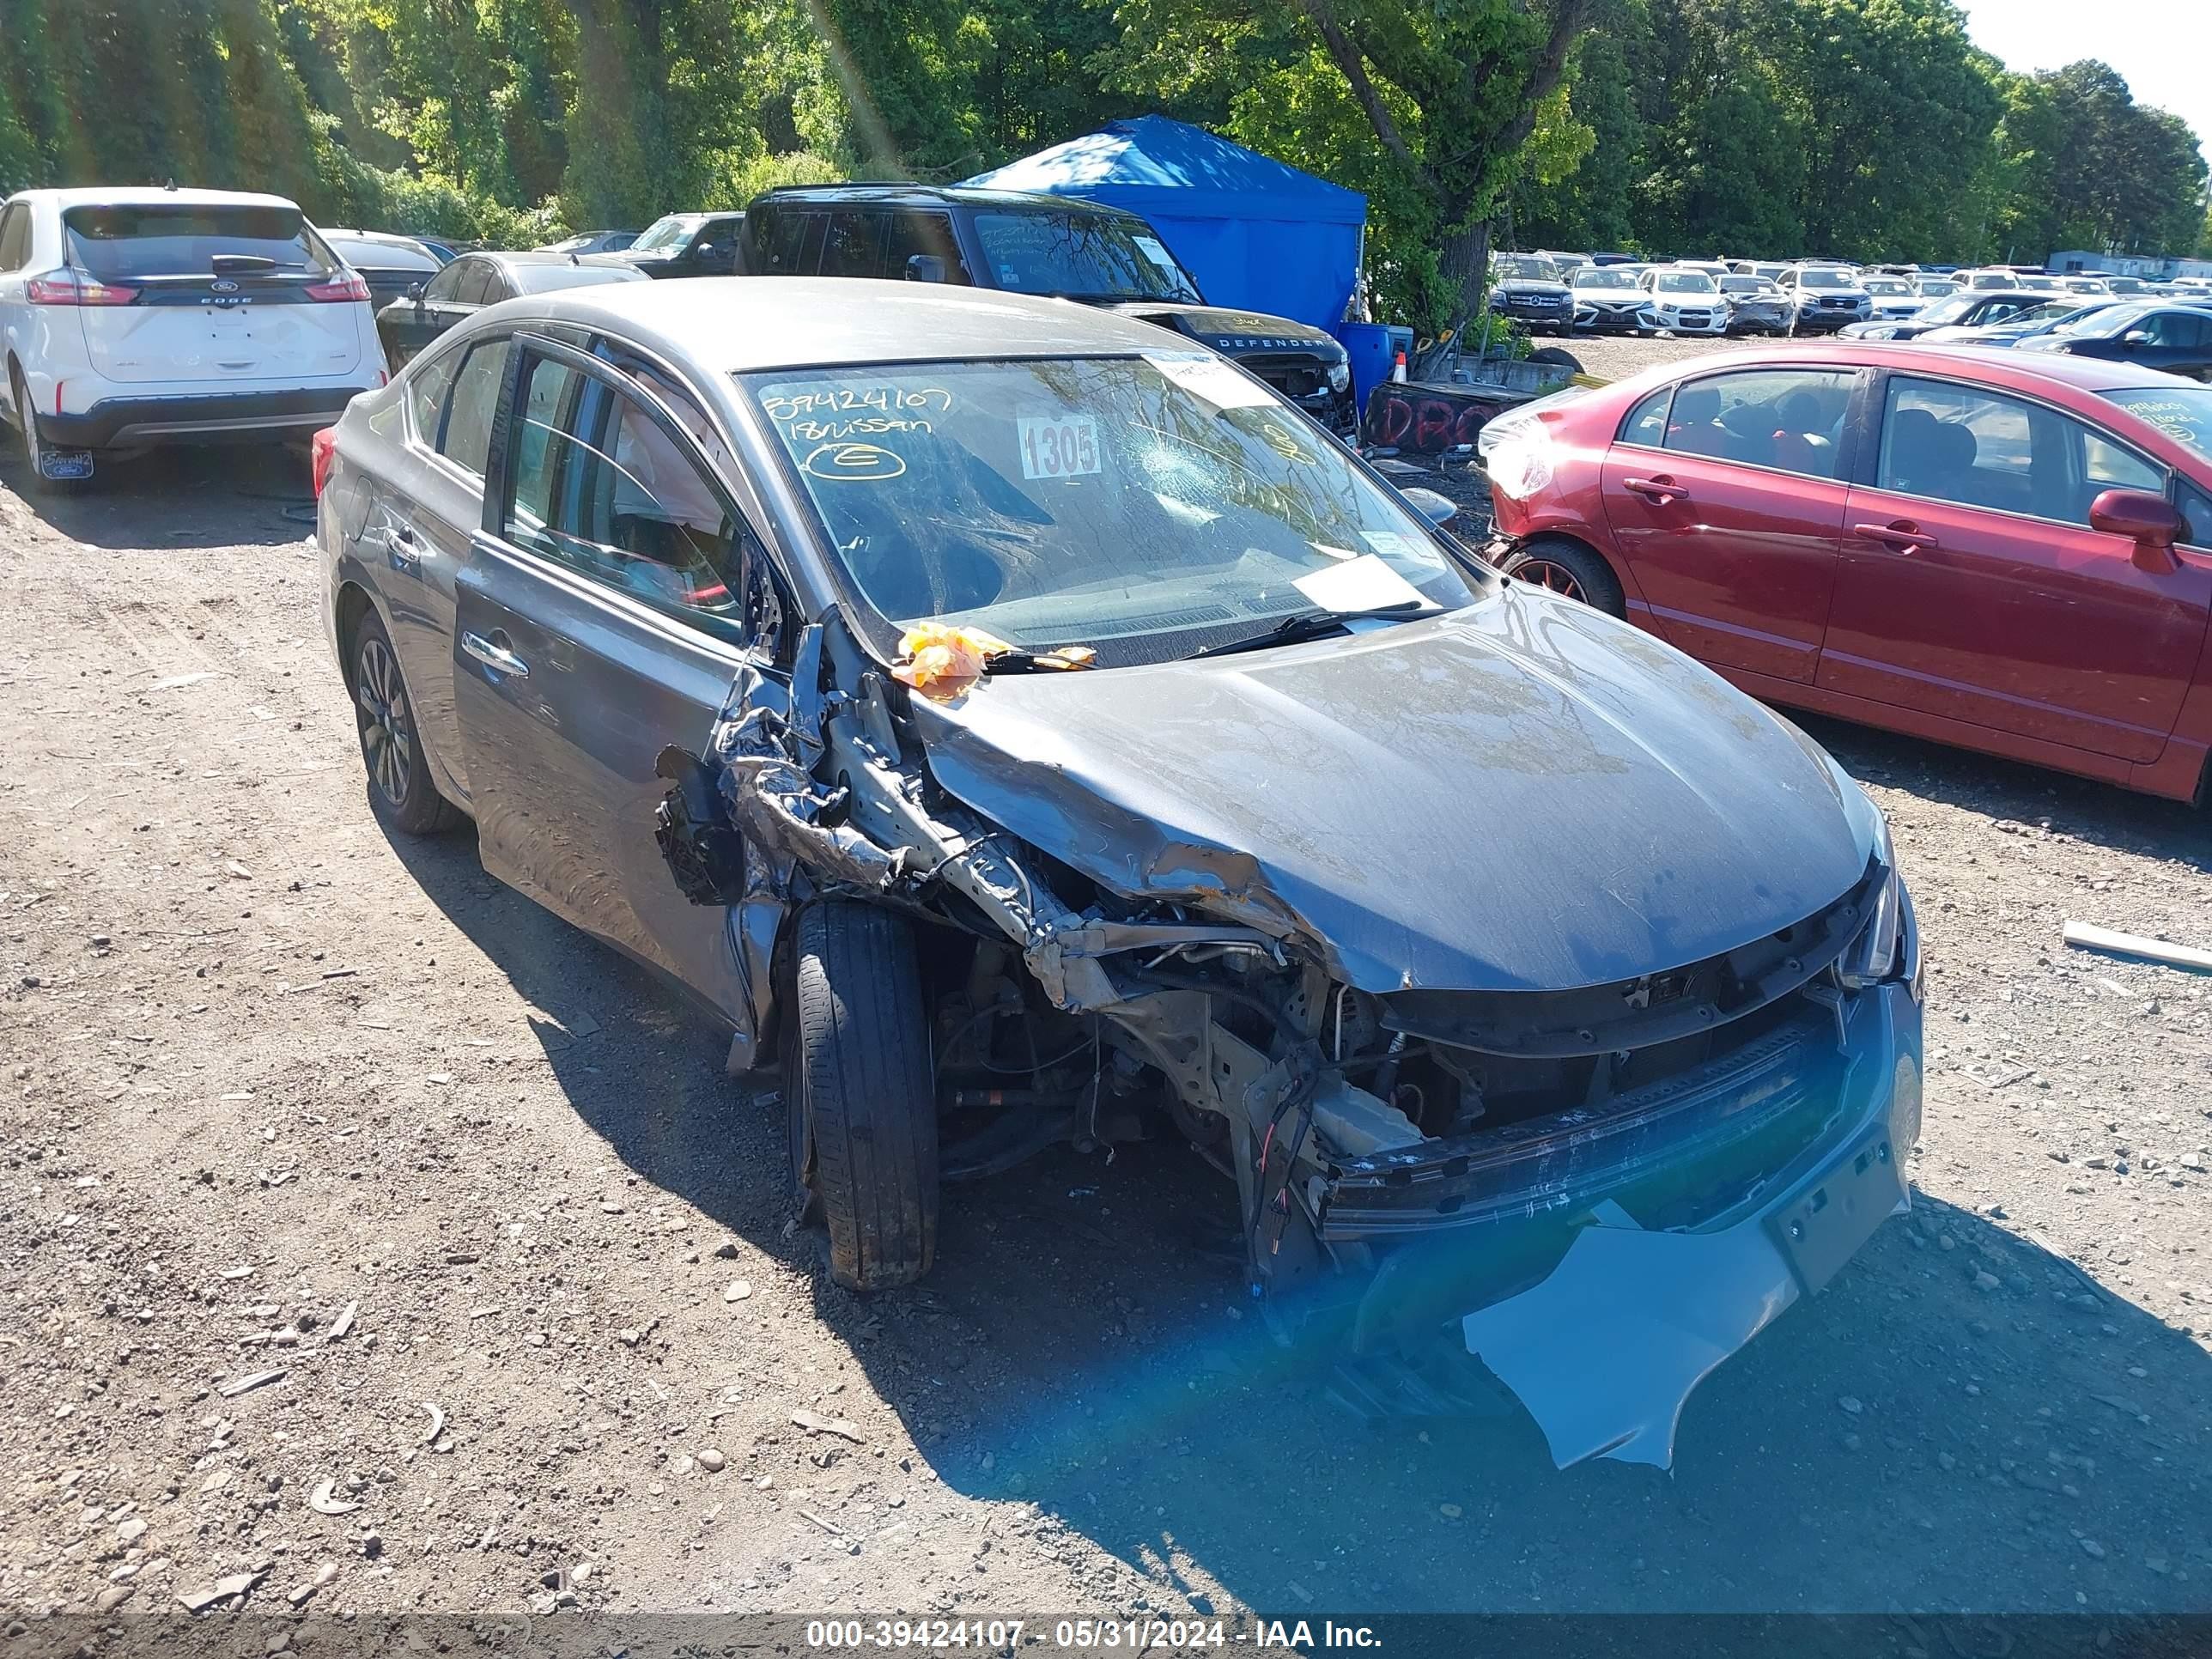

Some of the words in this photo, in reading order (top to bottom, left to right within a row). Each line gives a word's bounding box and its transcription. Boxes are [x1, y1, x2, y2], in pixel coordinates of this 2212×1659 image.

[1218, 338, 1326, 348] DEFENDER
[763, 390, 951, 420] 39424107
[1025, 425, 1096, 475] 1305
